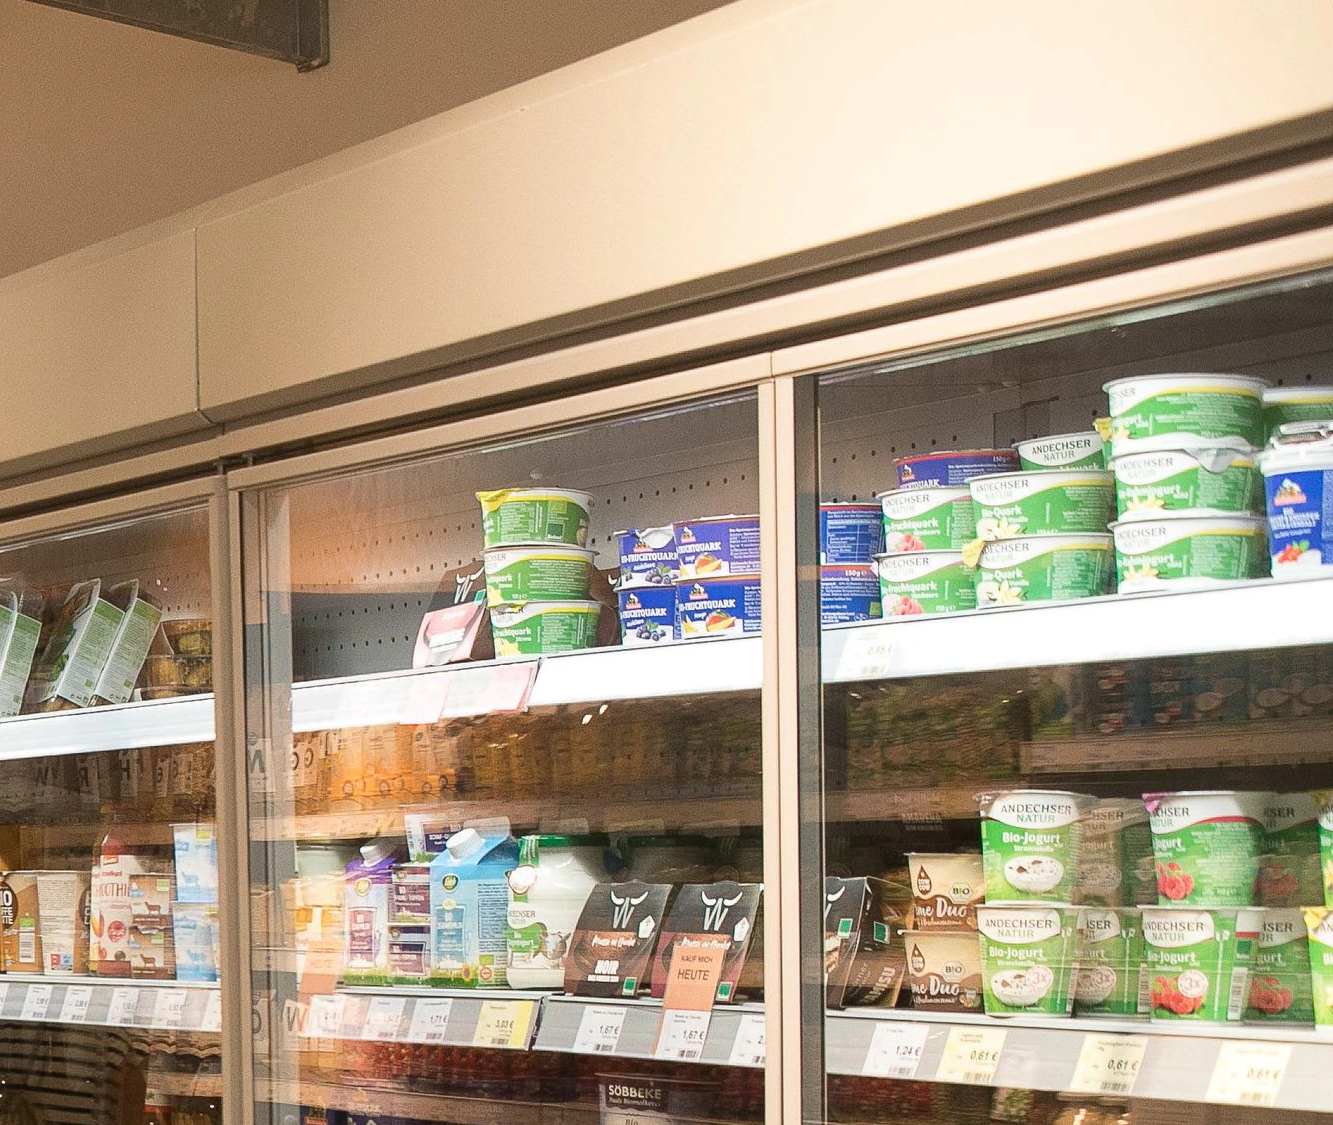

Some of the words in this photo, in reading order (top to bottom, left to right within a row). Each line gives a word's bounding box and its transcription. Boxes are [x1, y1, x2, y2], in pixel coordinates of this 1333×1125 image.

[1031, 438, 1092, 455] ANDECHSER
[1043, 450, 1076, 462] NATUR
[1001, 804, 1071, 814] ANDECHSER
[1016, 813, 1055, 823] NATUR
[1002, 832, 1060, 846] Bio-Jogurt
[936, 897, 967, 918] Duo
[985, 919, 1053, 929] ANDECHSER
[997, 928, 1034, 938] NATUR
[989, 946, 1044, 958] Bio-Jogurt
[677, 970, 710, 981] HEUTE
[929, 976, 960, 995] Duo
[599, 1026, 612, 1034] 1,67
[684, 1030, 697, 1039] 1,67
[895, 1045, 913, 1057] 1,24
[969, 1050, 988, 1062] 0,61
[1107, 1059, 1129, 1071] 0,61
[608, 1084, 662, 1100] SÖBBEKE
